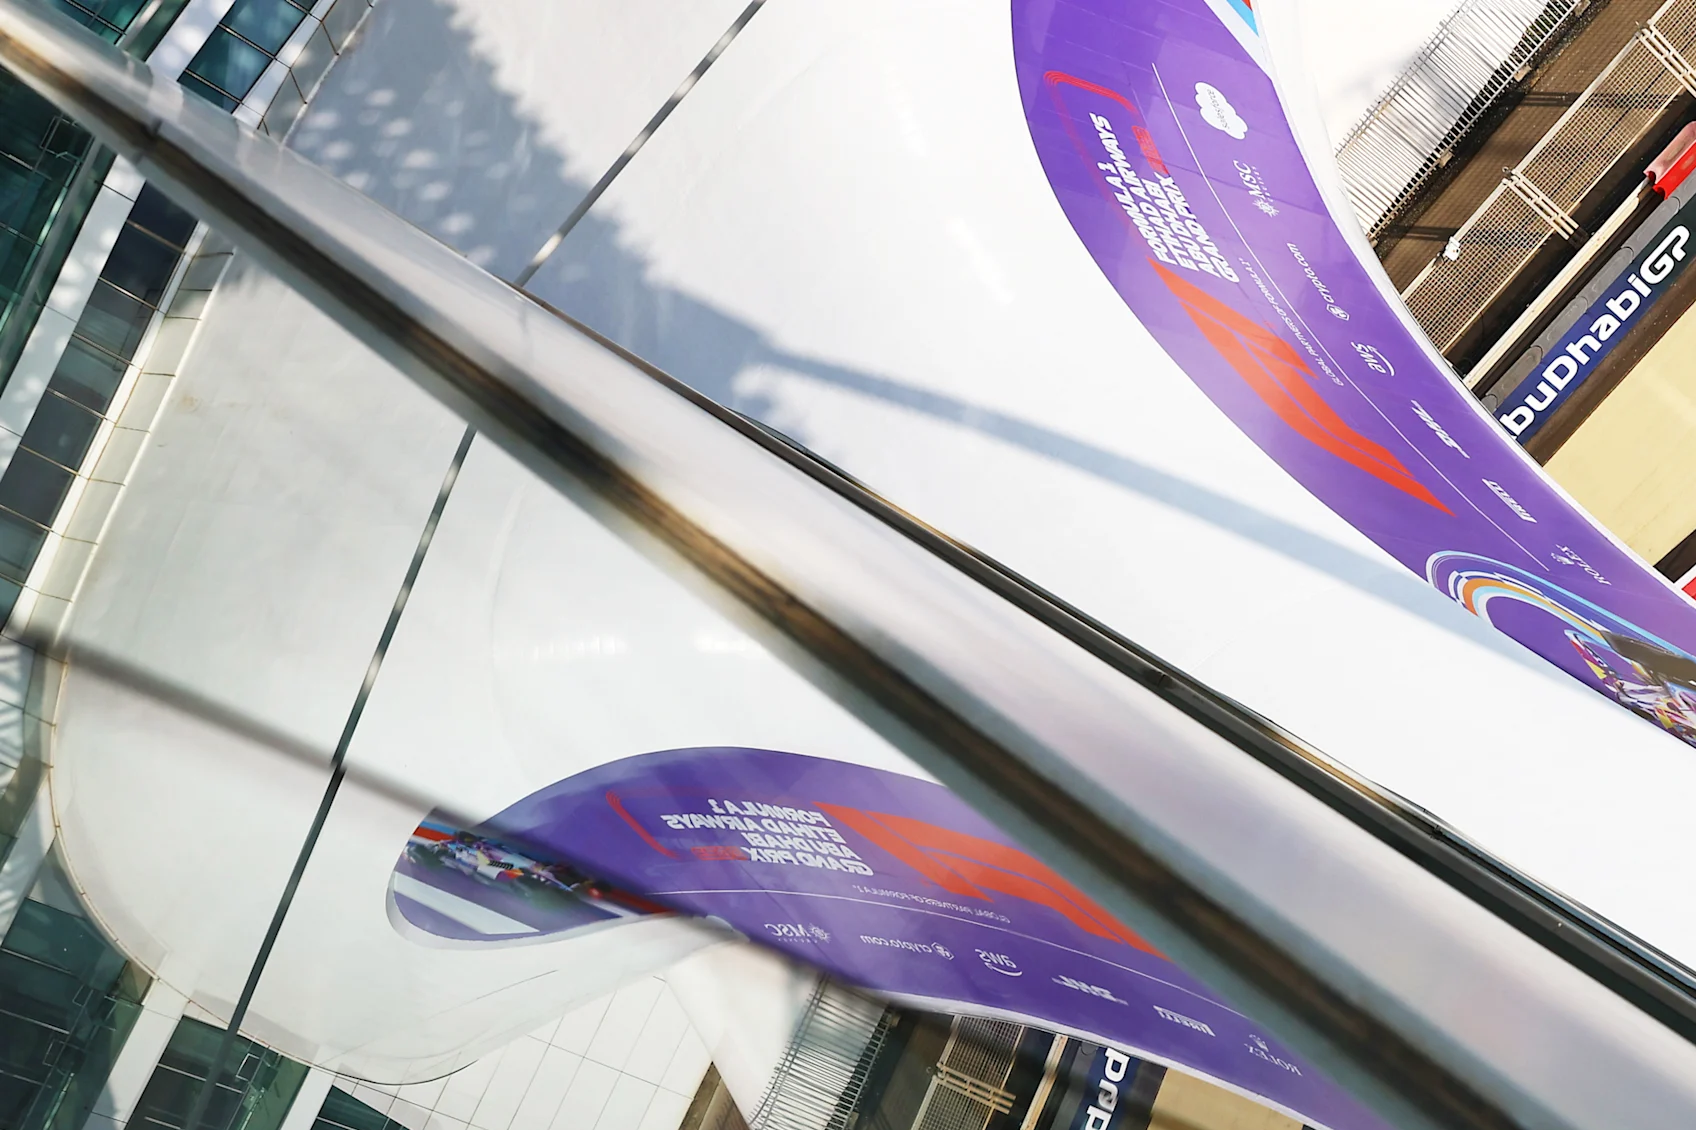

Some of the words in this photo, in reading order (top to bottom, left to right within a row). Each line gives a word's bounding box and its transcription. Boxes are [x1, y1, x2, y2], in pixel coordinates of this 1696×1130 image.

[1089, 112, 1153, 203] AIRWAYS
[1097, 161, 1118, 175] 1
[1233, 159, 1267, 201] MSC
[1141, 178, 1193, 239] DHABI
[1153, 171, 1197, 220] PRIX
[1105, 175, 1178, 265] FORMULA
[1138, 201, 1200, 271] ETIHAD
[1177, 235, 1223, 278] ABU
[1184, 219, 1240, 283] GRAND
[1286, 242, 1335, 304] crypto.com
[1245, 266, 1279, 307] FORMULA
[1272, 303, 1288, 318] OF
[1499, 225, 1691, 440] buDhabiGP
[1281, 315, 1319, 357] PARTNERS
[1350, 340, 1388, 375] aws
[1315, 356, 1345, 387] GLOBAL
[1411, 400, 1462, 450] DHL
[1481, 477, 1538, 524] PIRELLI
[1555, 543, 1612, 586] ROLEX
